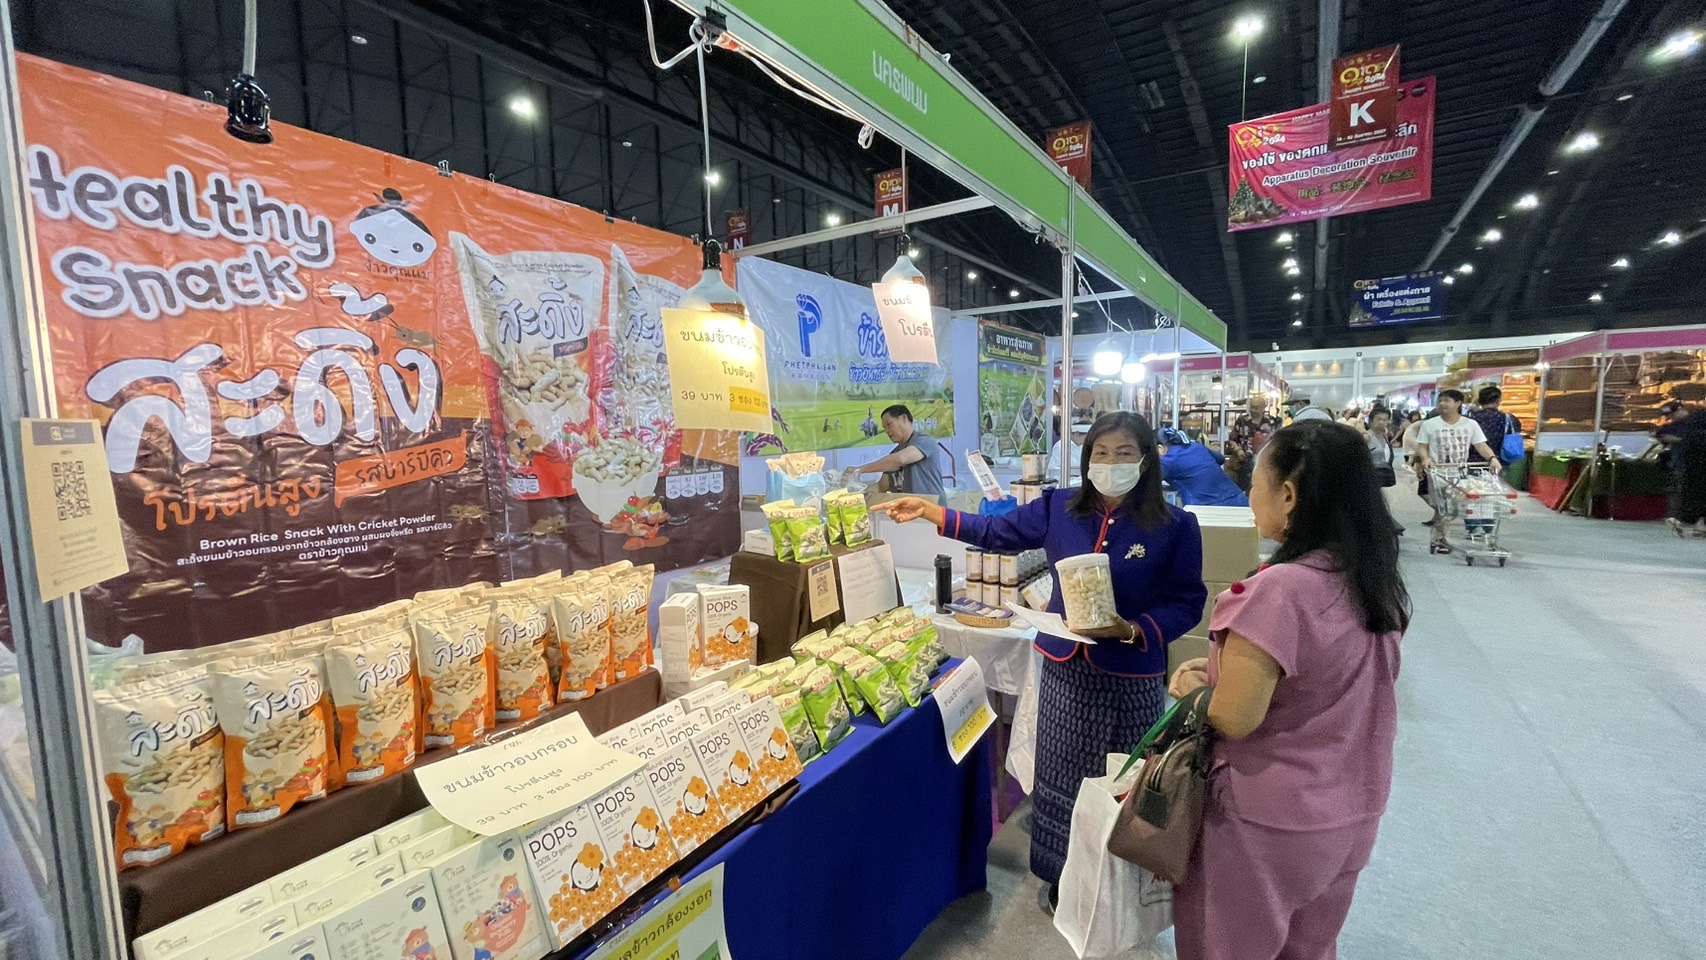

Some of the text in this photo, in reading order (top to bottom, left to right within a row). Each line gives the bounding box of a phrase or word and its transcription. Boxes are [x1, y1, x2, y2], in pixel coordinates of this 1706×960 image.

[872, 50, 928, 115] นครพนม
[1350, 98, 1375, 127] K
[1263, 134, 1286, 146] 2024
[1262, 145, 1418, 187] Apparatus Decoration Souvenir
[883, 202, 899, 218] M
[733, 236, 744, 250] N
[51, 244, 307, 320] Snack
[496, 276, 585, 345] สะดิ้ง
[85, 283, 443, 474] สะดิ้ง
[681, 390, 696, 401] 39
[700, 393, 723, 401] บาท
[730, 393, 736, 402] 3
[354, 445, 455, 488] รสบาร์บีคิว
[143, 476, 321, 531] โปรตีนสูง
[200, 512, 437, 550] Brown Rice Snack With Cricket Powder
[706, 600, 738, 614] POPS
[501, 609, 548, 646] สะดิ้ง
[248, 668, 323, 725] สะดิ้ง
[740, 710, 770, 734] POPS
[696, 733, 711, 745] Natural
[698, 732, 731, 759] POPS
[443, 734, 579, 794] ขนมข้าวอบกรอบ
[646, 754, 674, 773] Natural Rice
[704, 747, 729, 766] 100% Organic
[504, 767, 563, 795] โปรตีนสูง
[648, 757, 685, 788] POPS
[655, 775, 684, 795] 100% Organic
[477, 757, 618, 826] 39 บาท 3 ซอง 100 บาท
[594, 786, 635, 820] POPS
[600, 805, 632, 828] 100% Organic
[525, 824, 549, 840] Natural
[529, 820, 578, 860] POPS
[535, 842, 574, 868] 100% Organic
